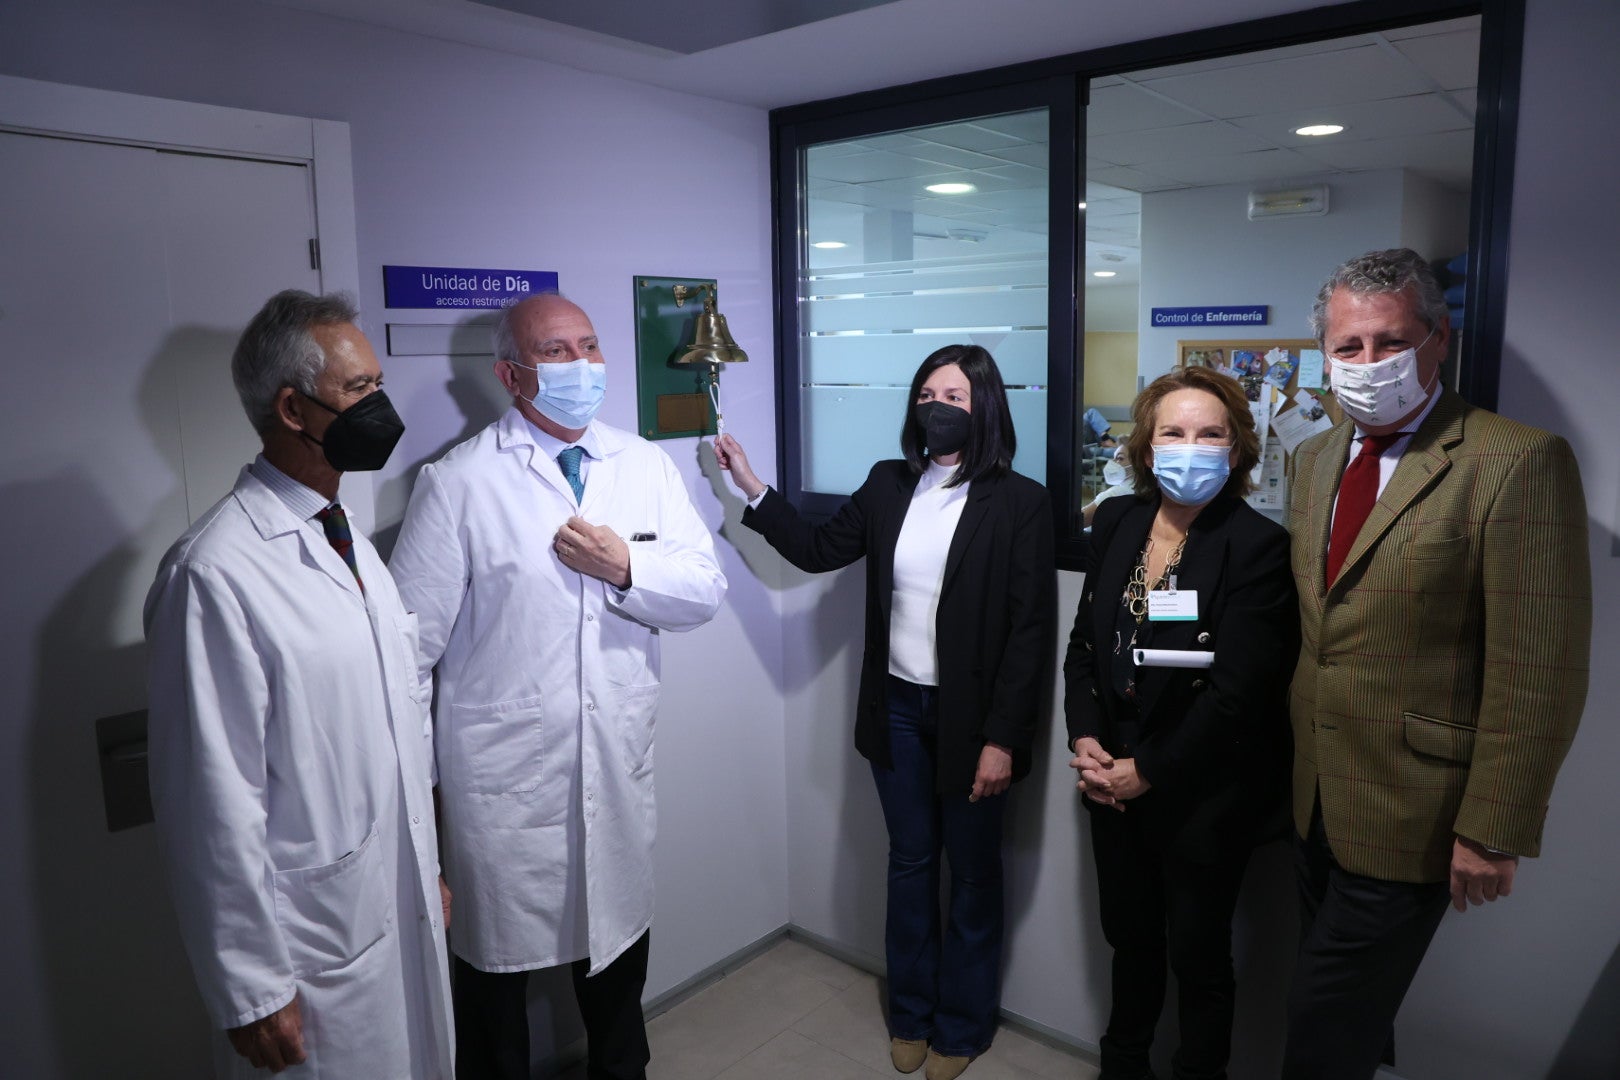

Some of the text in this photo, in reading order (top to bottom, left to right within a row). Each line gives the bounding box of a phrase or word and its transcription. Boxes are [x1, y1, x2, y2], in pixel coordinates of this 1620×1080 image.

[422, 273, 530, 292] Unidad de Día
[436, 296, 469, 306] acceso
[1155, 311, 1263, 323] Control de Enfermería
